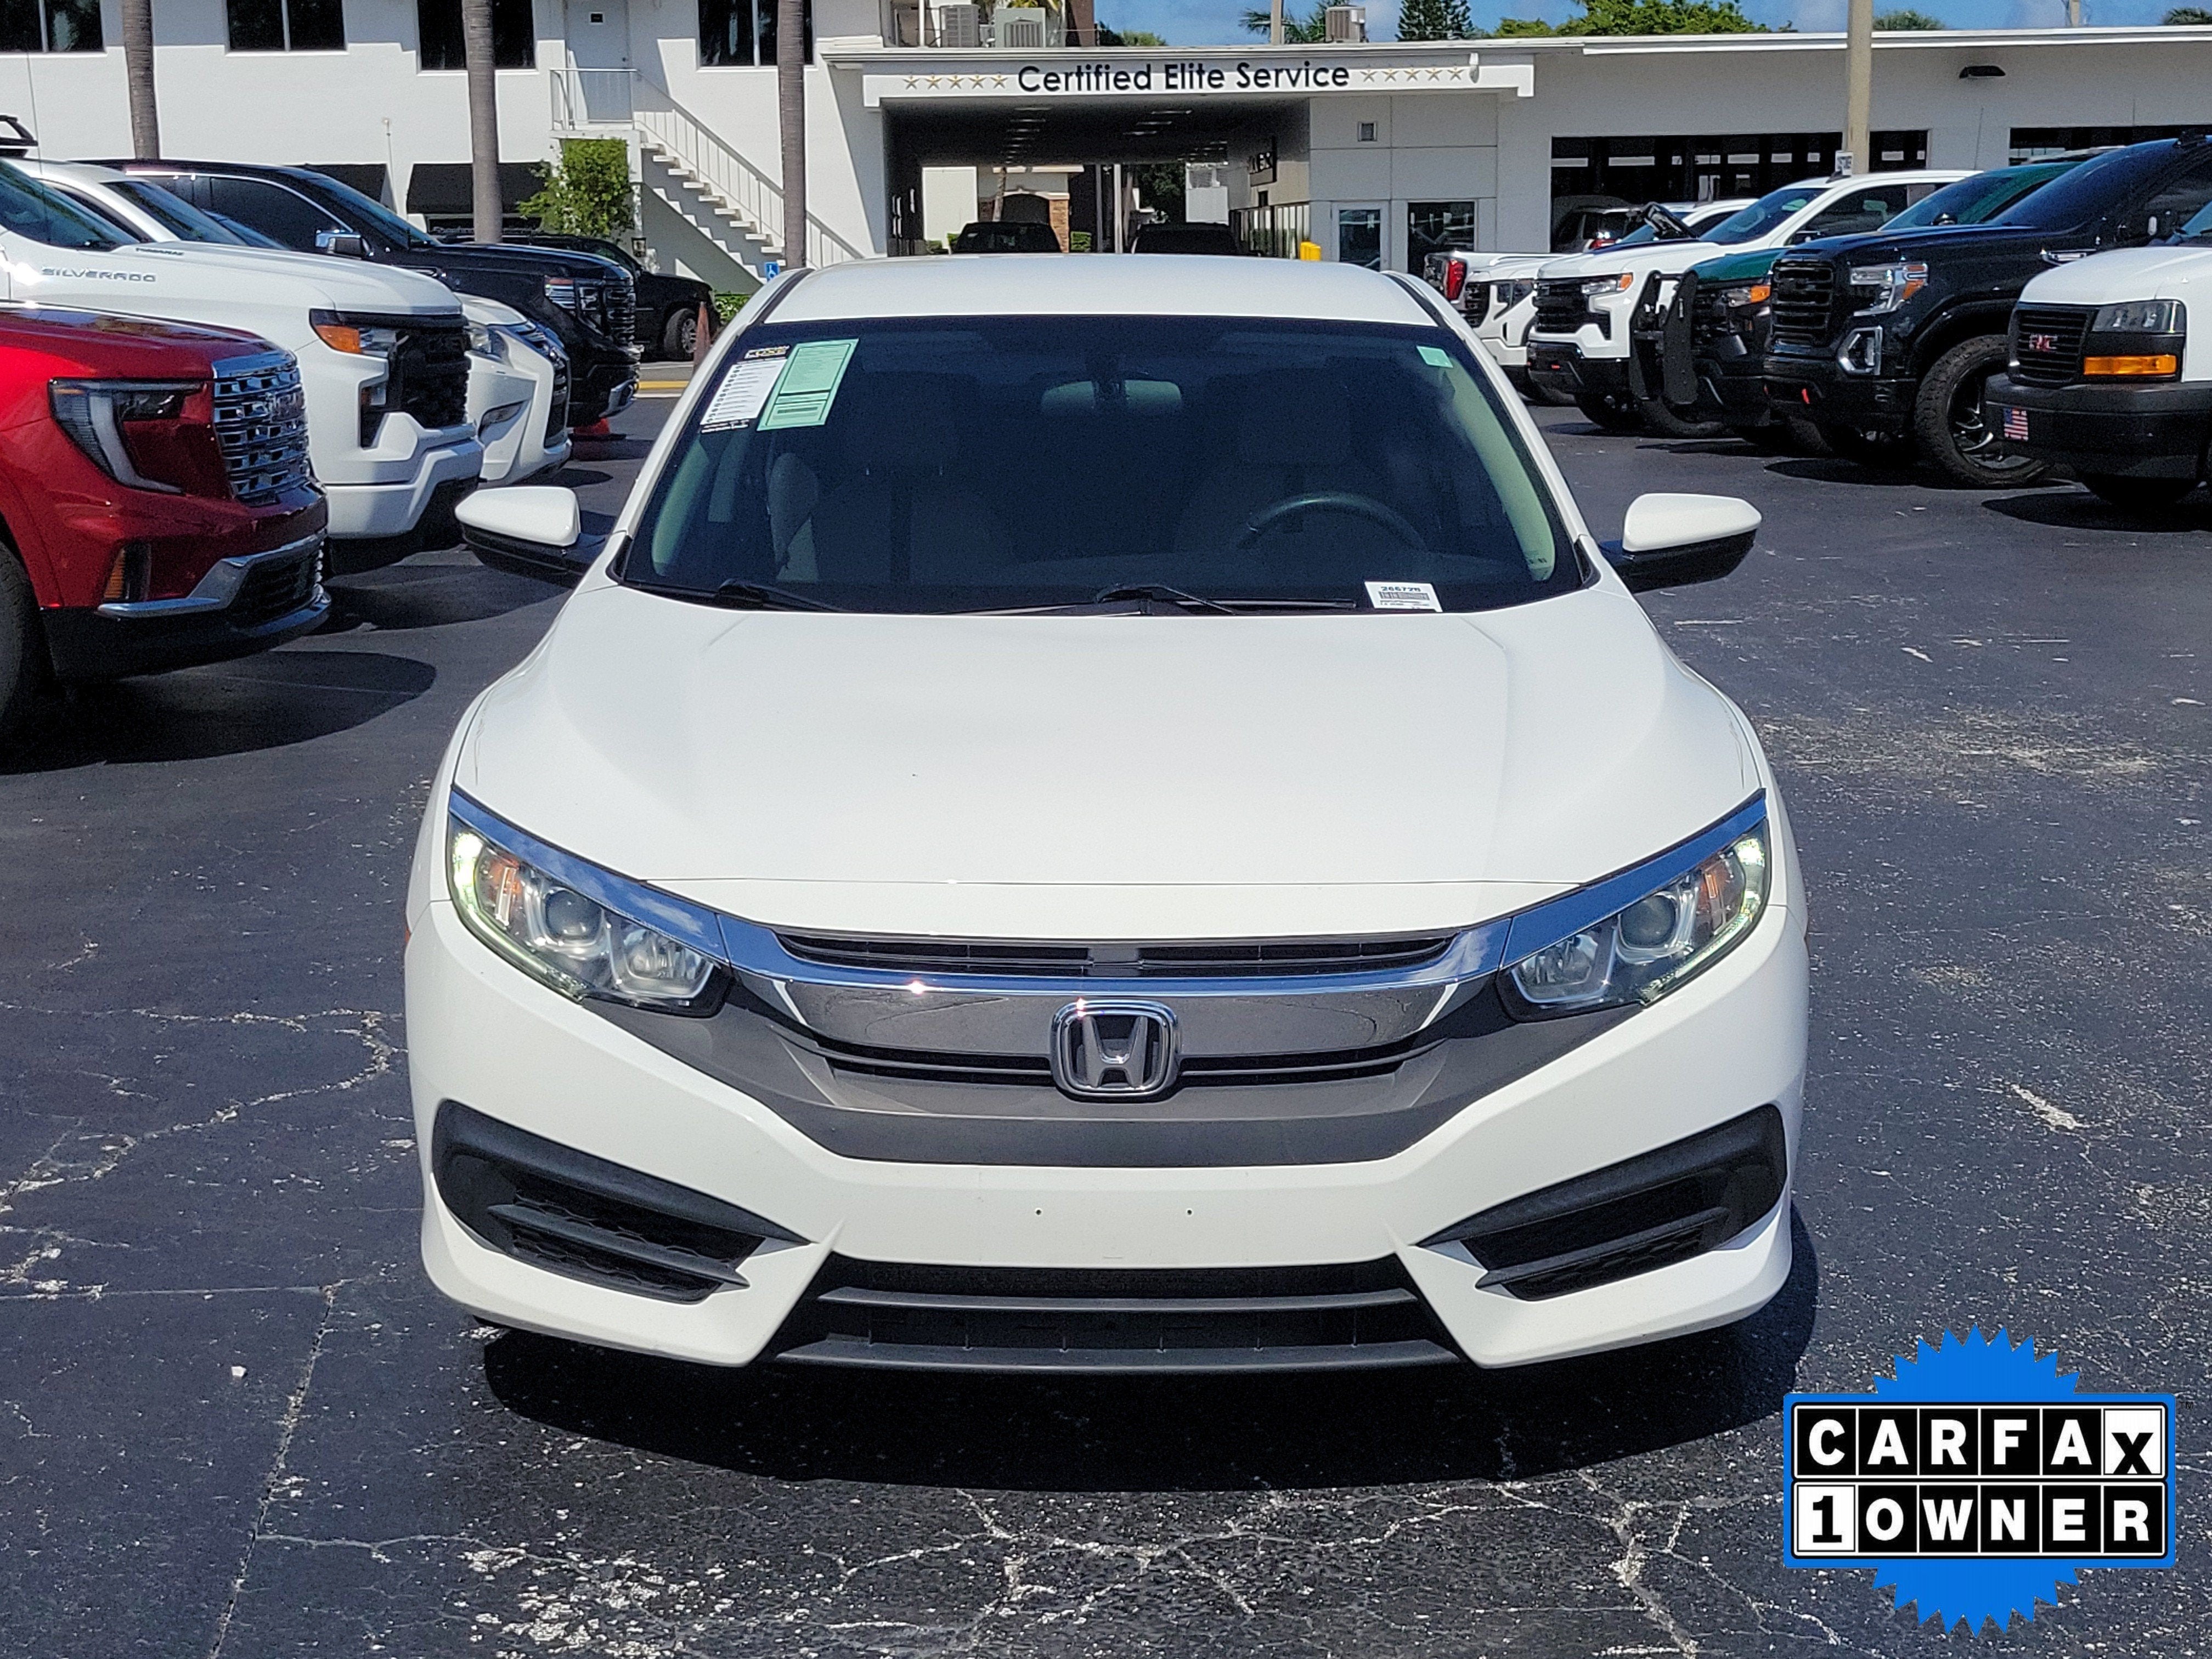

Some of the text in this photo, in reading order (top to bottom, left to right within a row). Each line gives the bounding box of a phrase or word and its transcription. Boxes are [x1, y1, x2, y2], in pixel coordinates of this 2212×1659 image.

[1018, 60, 1350, 92] Certified Elite Service
[41, 267, 156, 282] SILVERADO
